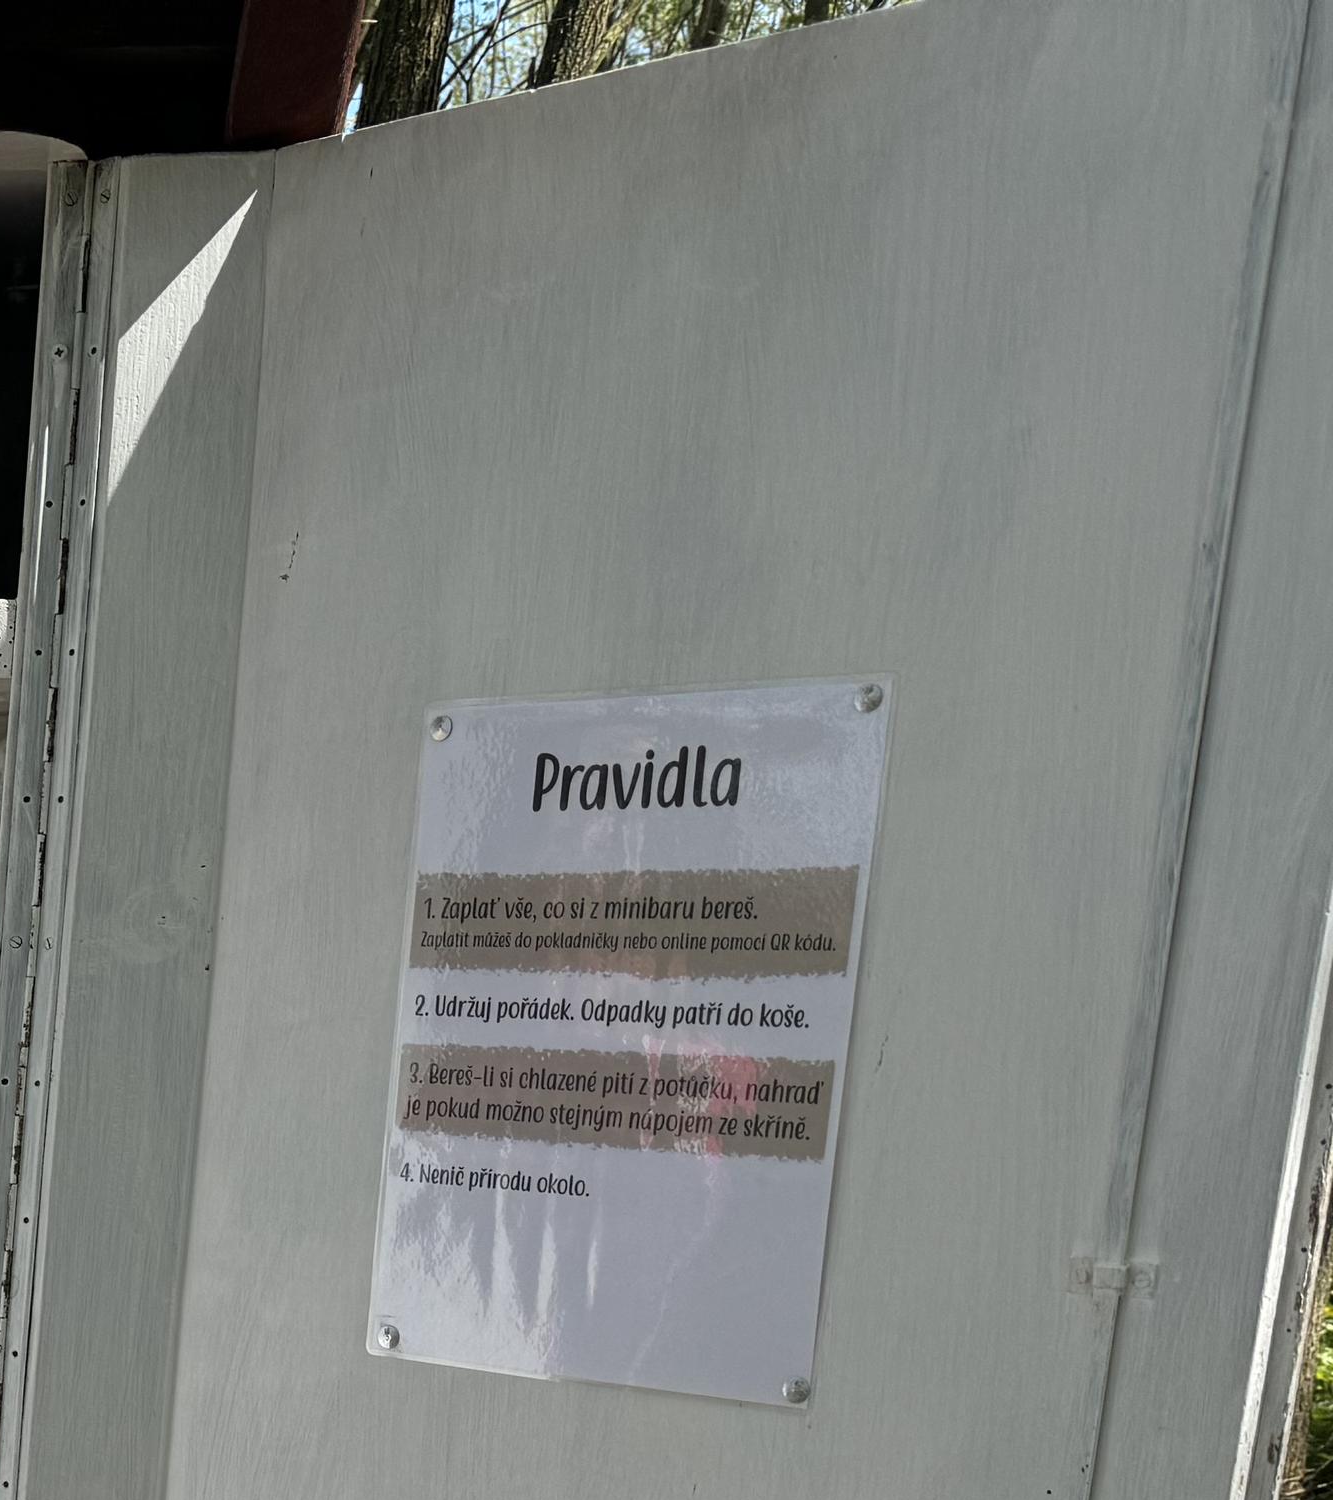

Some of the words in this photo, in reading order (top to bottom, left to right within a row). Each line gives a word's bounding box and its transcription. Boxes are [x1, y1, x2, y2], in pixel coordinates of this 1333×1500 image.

[532, 744, 742, 813] Pravidla
[424, 897, 435, 919] 1.
[441, 897, 501, 923] Zaplať
[505, 897, 537, 923] vše,
[543, 900, 565, 919] co
[570, 897, 585, 919] si
[589, 901, 598, 919] z
[604, 896, 694, 920] minibaru
[701, 896, 758, 920] bereš.
[421, 931, 470, 951] Zaplatit
[473, 931, 512, 948] můžeš
[515, 931, 532, 948] do
[535, 931, 619, 953] pokladničky
[623, 932, 657, 949] nebo
[661, 932, 707, 950] online
[711, 933, 766, 953] pomocí
[771, 933, 790, 951] QR
[795, 934, 836, 951] kódu.
[415, 994, 429, 1017] 2.
[435, 995, 492, 1023] Udržuj
[497, 997, 574, 1024] pořádek.
[581, 998, 667, 1029] Odpadky
[672, 1001, 722, 1029] patří
[727, 1003, 753, 1028] do
[759, 1003, 810, 1028] koše.
[409, 1062, 423, 1084] 3.
[429, 1063, 494, 1088] Bereš-li
[500, 1068, 513, 1089] si
[519, 1068, 597, 1093] chlazené
[602, 1072, 634, 1098] pití
[639, 1076, 648, 1096] z
[654, 1075, 738, 1105] potůčku,
[745, 1079, 824, 1105] nahraď
[403, 1095, 421, 1120] je
[426, 1096, 480, 1122] pokud
[485, 1100, 544, 1124] možno
[549, 1103, 623, 1132] stejným
[628, 1107, 713, 1137] nápojem
[718, 1116, 737, 1136] ze
[744, 1114, 810, 1141] skříně.
[400, 1162, 414, 1183] 4.
[419, 1163, 464, 1186] Nenič
[468, 1166, 532, 1192] přírodu
[537, 1173, 590, 1197] okolo.
